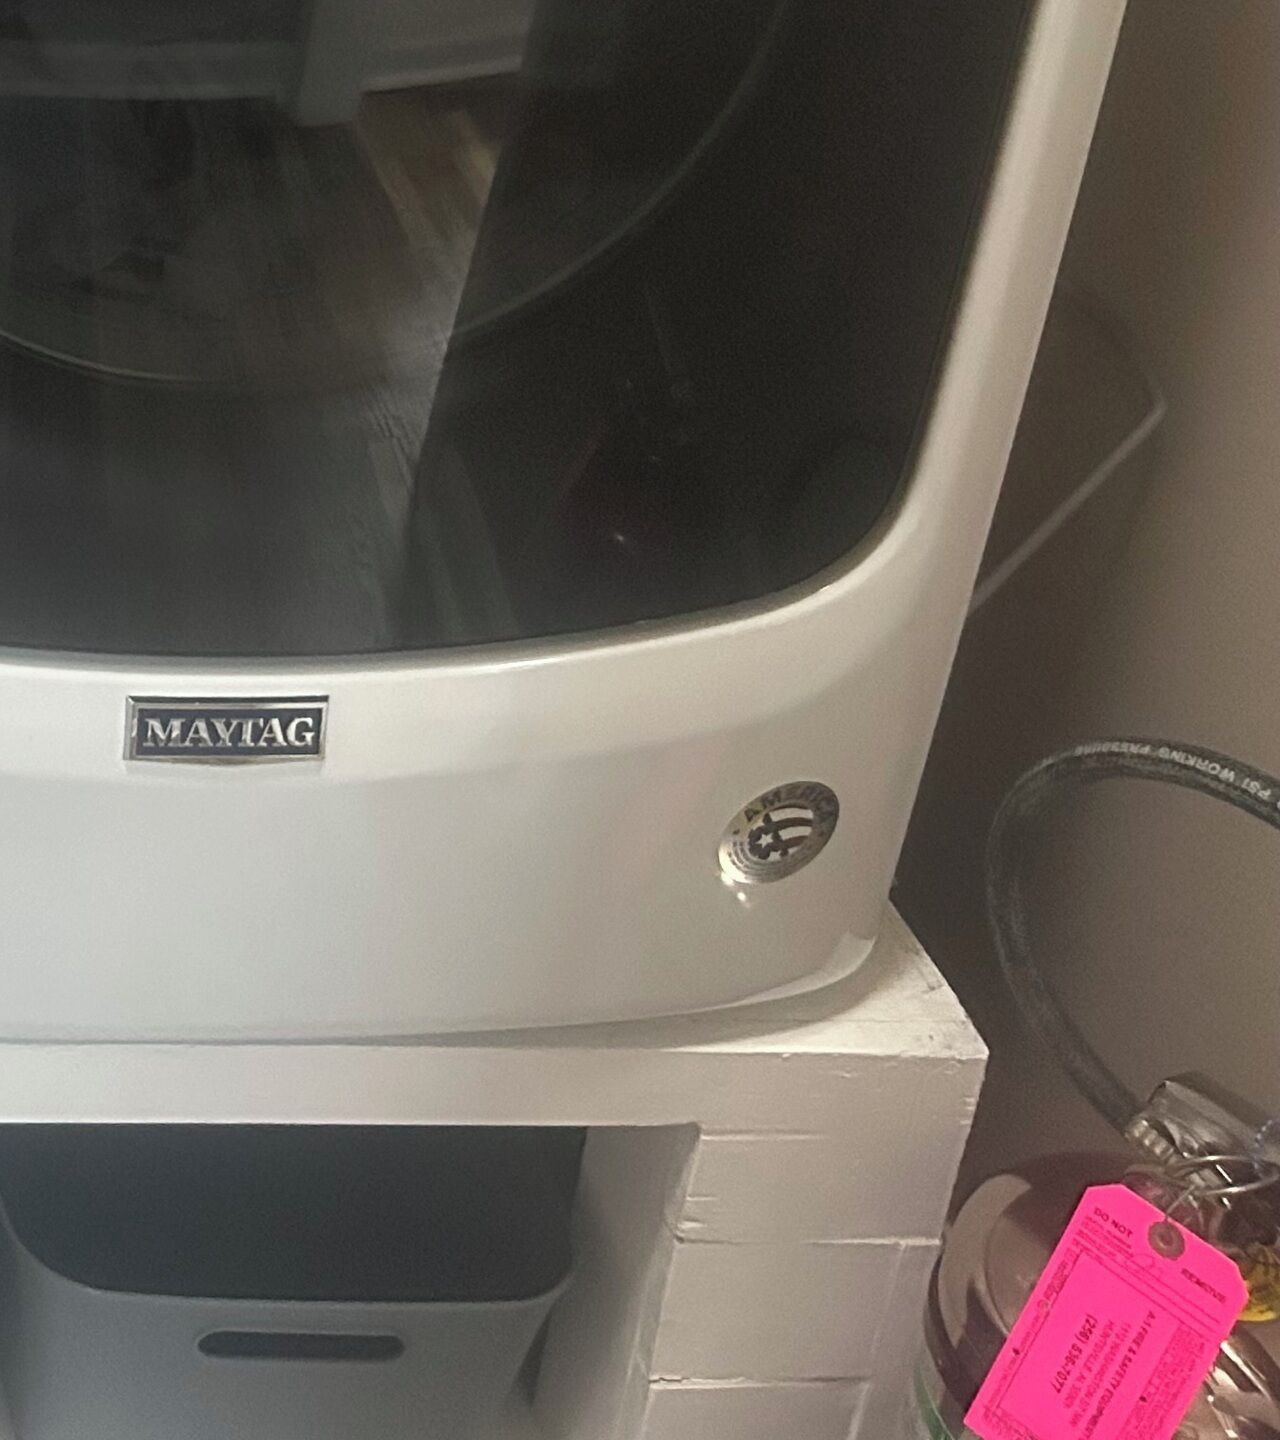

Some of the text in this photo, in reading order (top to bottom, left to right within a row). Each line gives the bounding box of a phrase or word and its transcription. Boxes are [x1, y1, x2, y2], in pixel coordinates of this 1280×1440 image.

[143, 718, 315, 747] MAYTAG
[1094, 1208, 1109, 1222] DO
[1111, 1218, 1134, 1238] NOT
[1074, 1312, 1097, 1345] (256)
